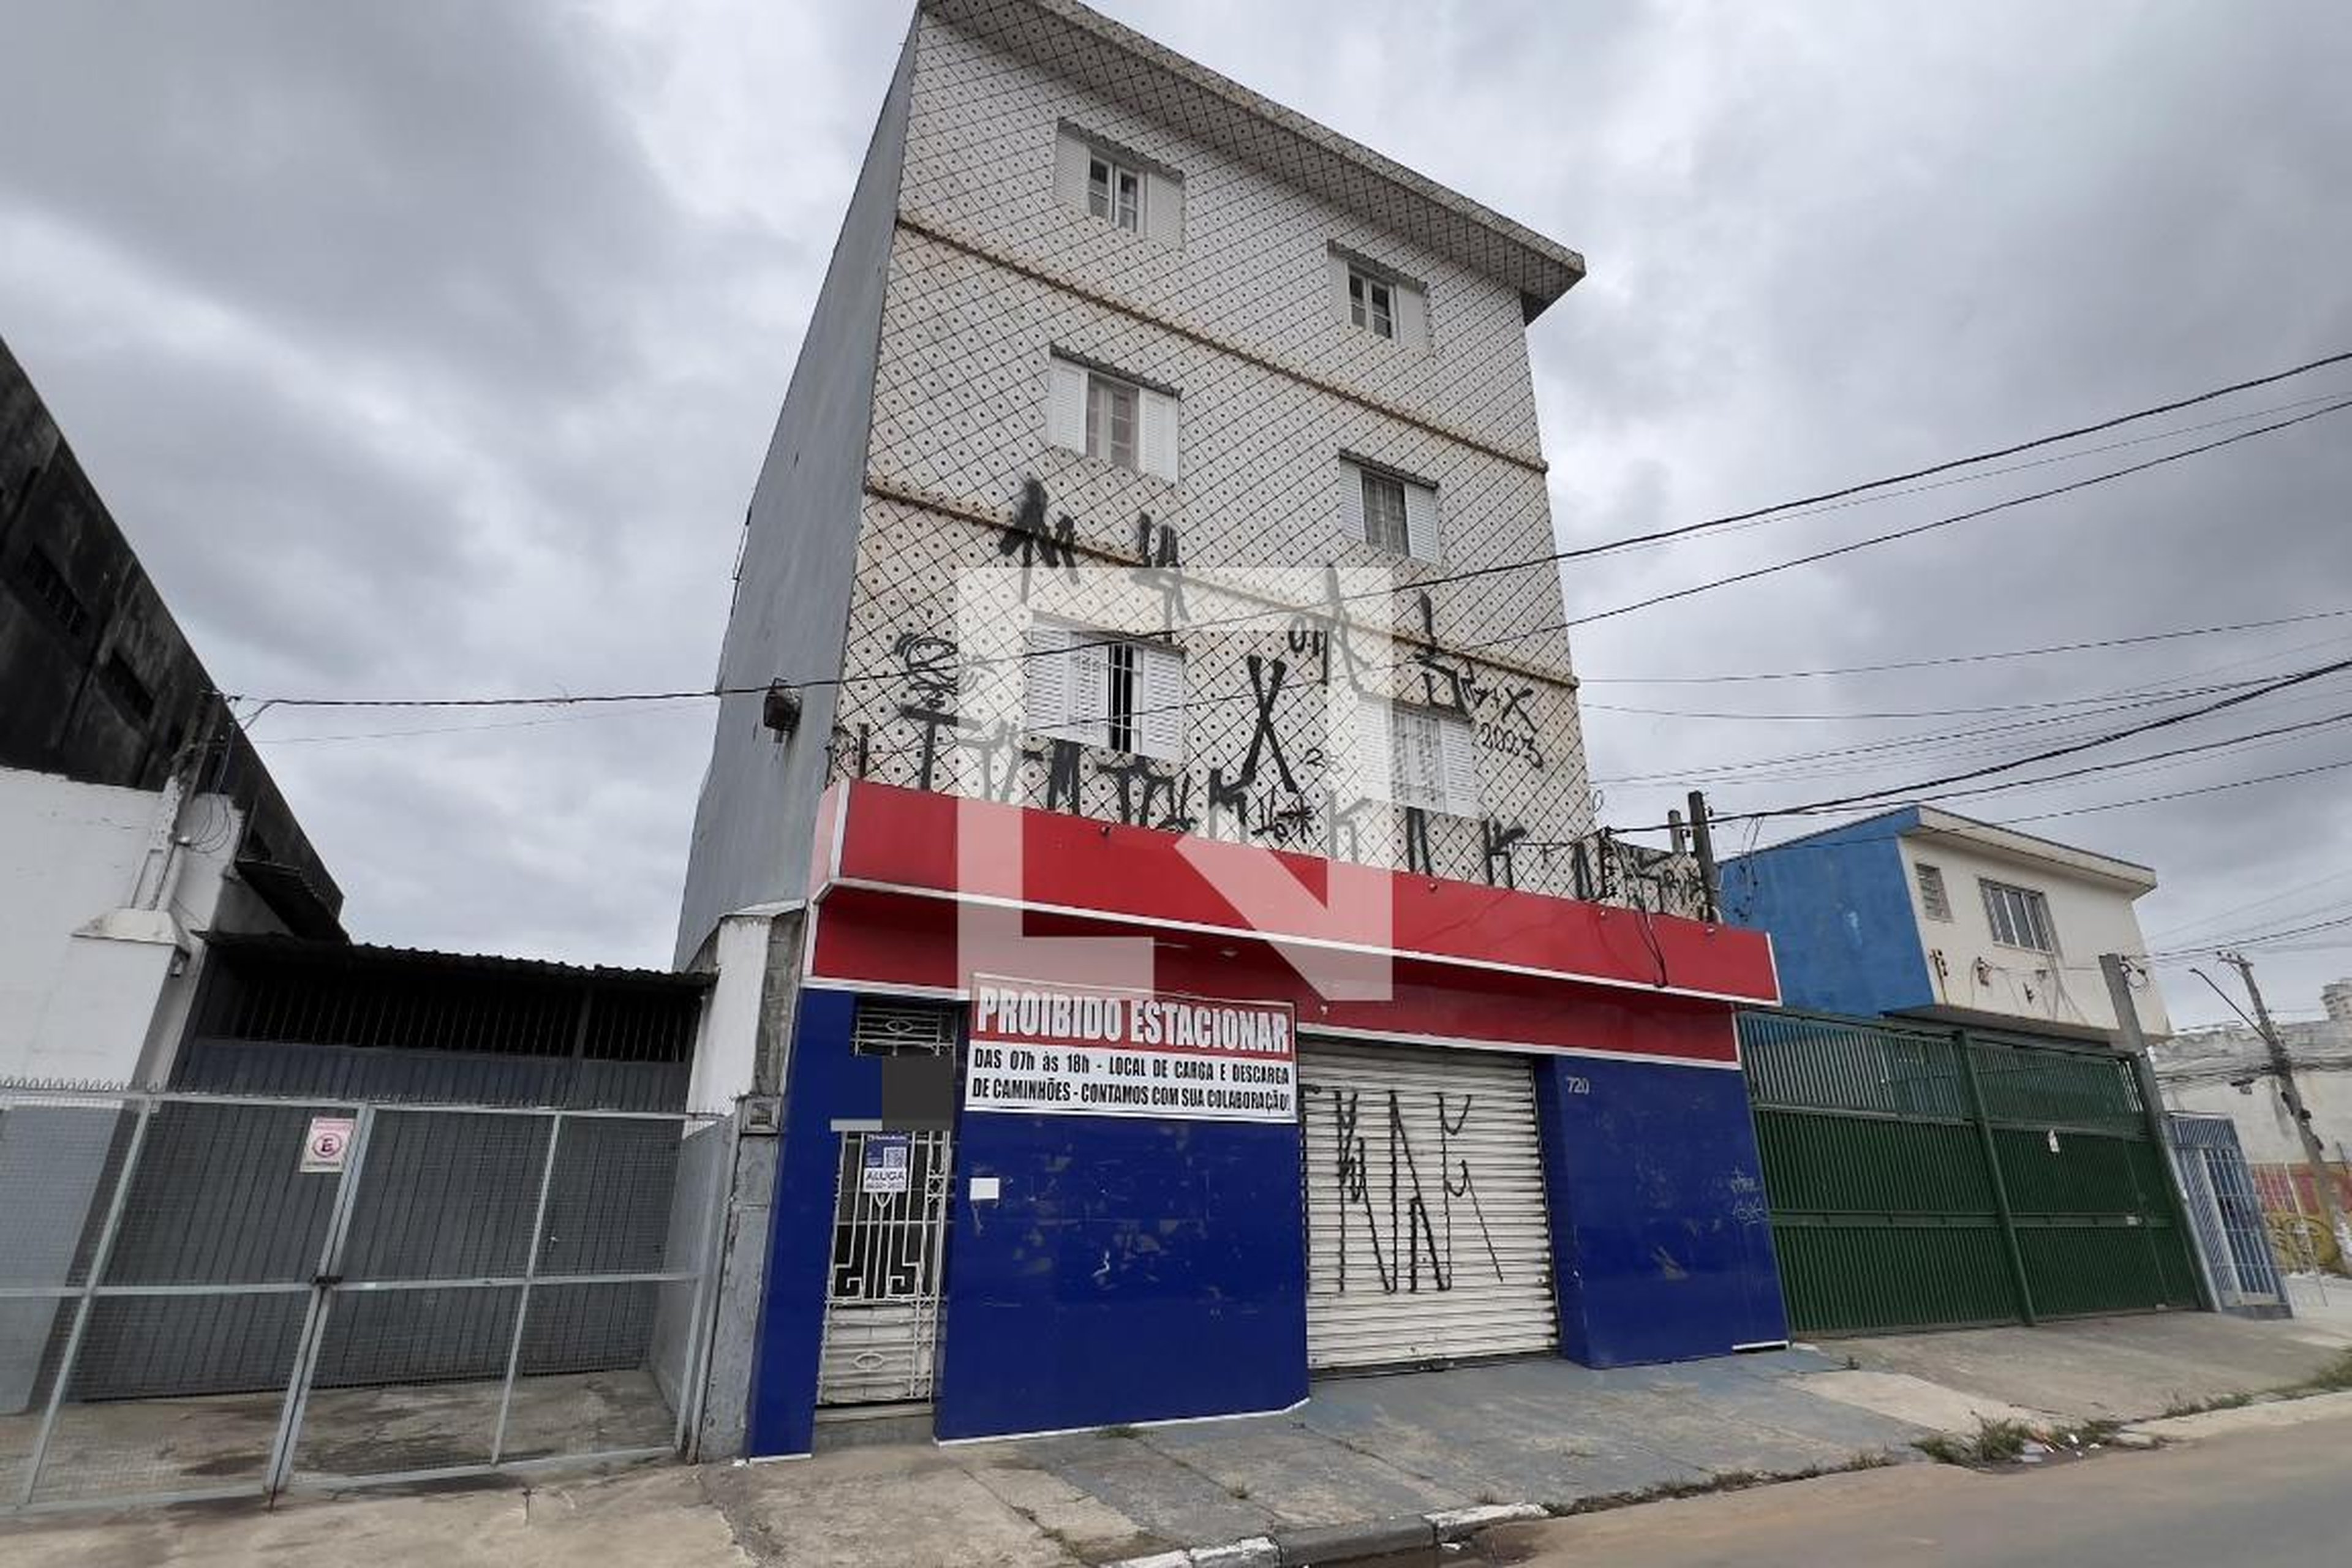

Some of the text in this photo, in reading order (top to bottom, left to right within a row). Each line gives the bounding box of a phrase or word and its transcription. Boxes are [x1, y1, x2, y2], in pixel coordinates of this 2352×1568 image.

[978, 987, 1289, 1054] PROIBIDO ESTACIONAR
[974, 1048, 1002, 1069] DAS
[1009, 1050, 1035, 1071] 07h
[1068, 1054, 1090, 1074] 18h
[1109, 1056, 1146, 1077] LOCAL
[1153, 1059, 1168, 1079] DE
[1175, 1060, 1214, 1081] CARGA
[1220, 1063, 1226, 1081] E
[1232, 1064, 1289, 1085] DESCARGA
[972, 1077, 989, 1098] DE
[993, 1077, 1071, 1101] CAMINHÕES
[1080, 1082, 1149, 1106] CONTAMOS
[1152, 1086, 1179, 1106] COM
[1181, 1087, 1205, 1107] SUA
[1566, 1076, 1589, 1095] 720
